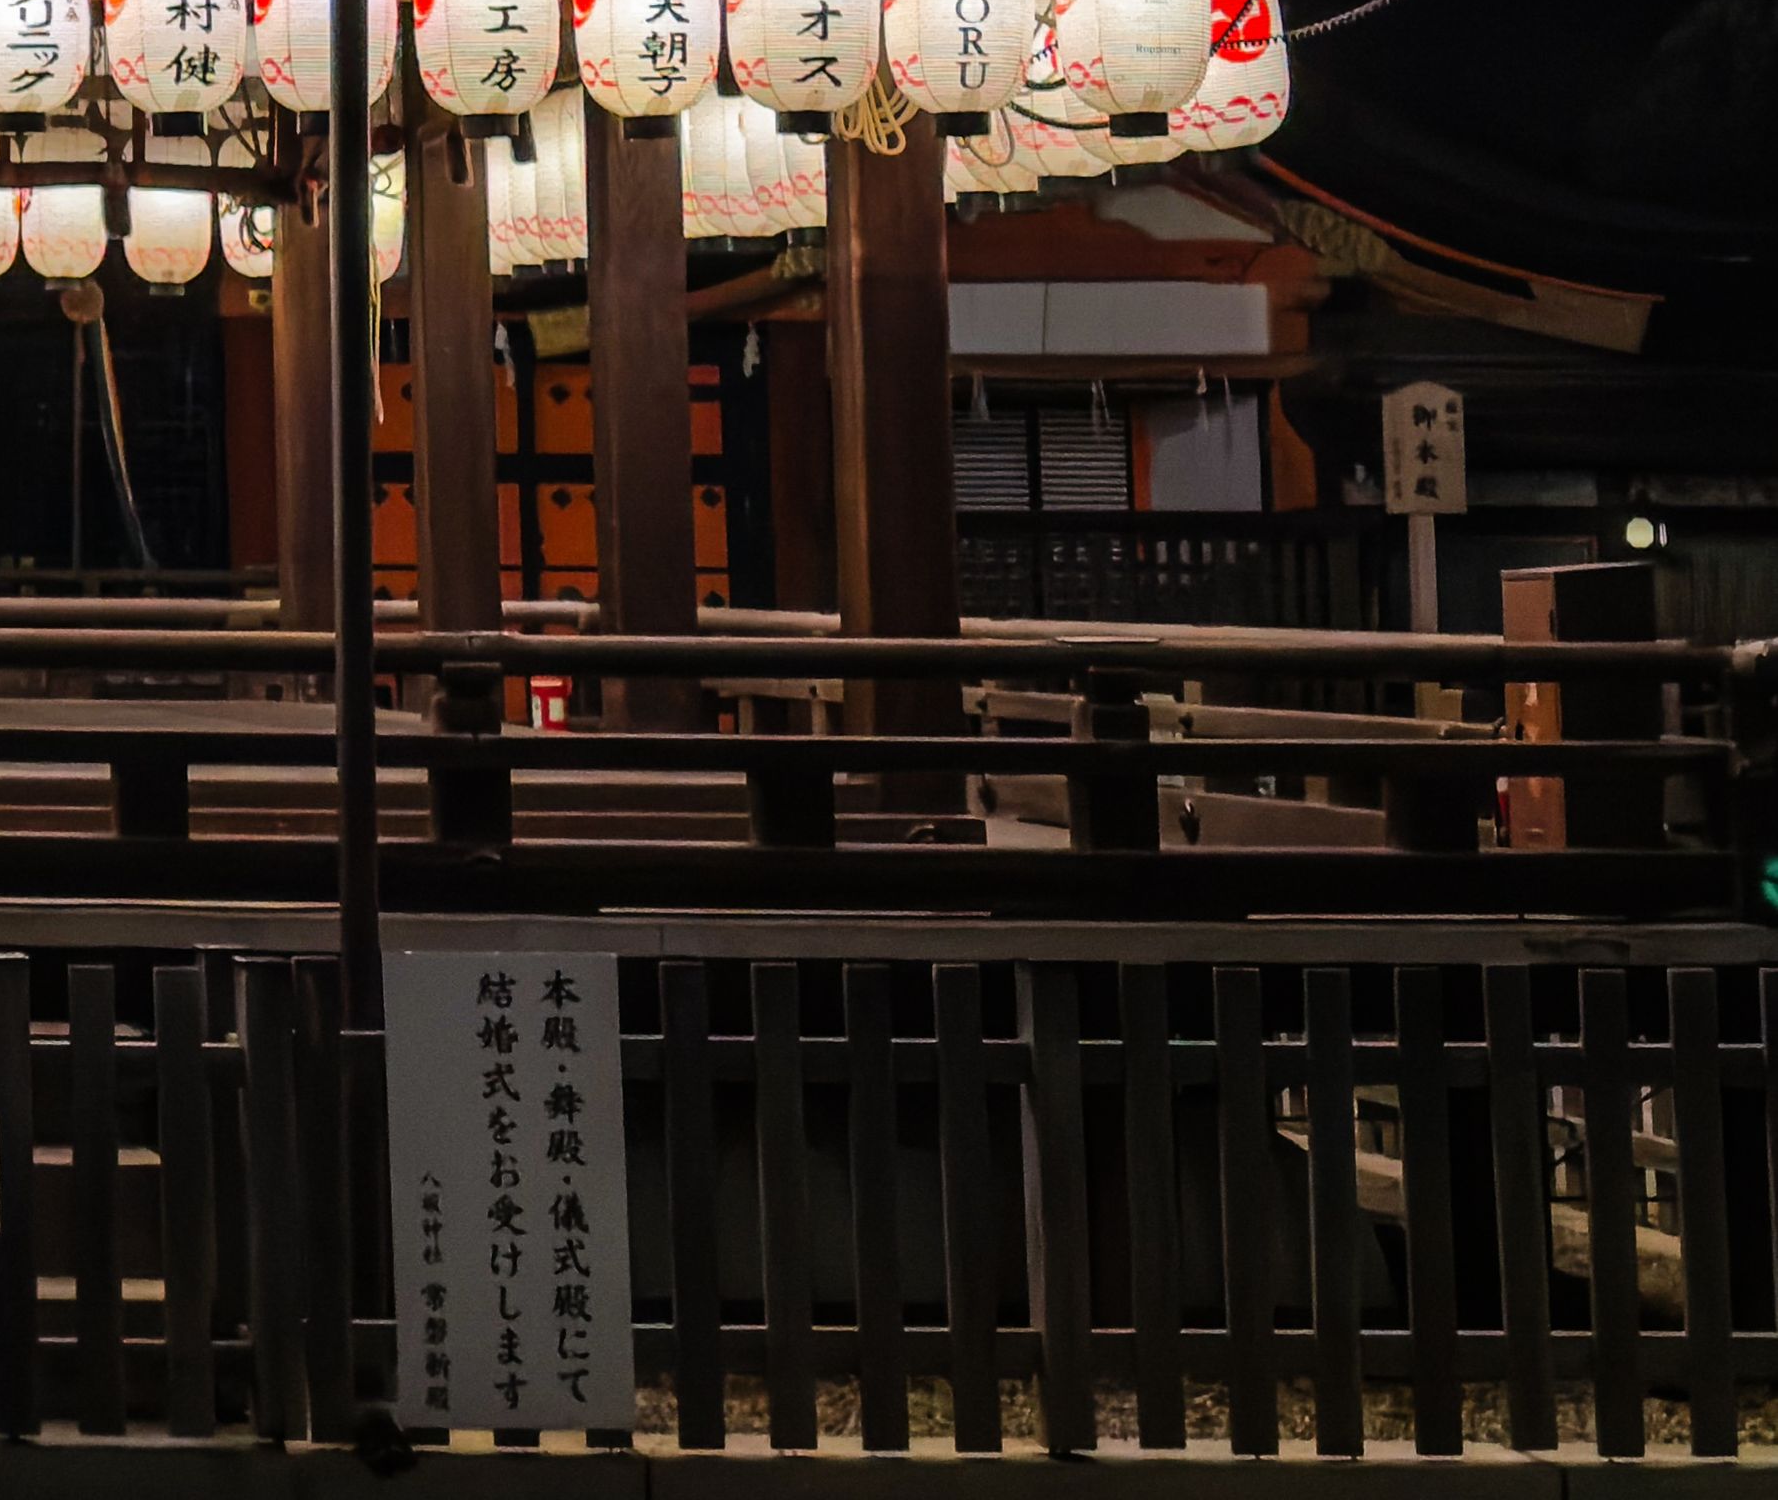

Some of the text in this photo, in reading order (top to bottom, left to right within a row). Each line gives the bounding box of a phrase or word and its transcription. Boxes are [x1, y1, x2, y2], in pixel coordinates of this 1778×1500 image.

[477, 972, 527, 1410] 結婚式をお受けします
[541, 969, 591, 1403] 本殿・舞殿・儀式殿にて
